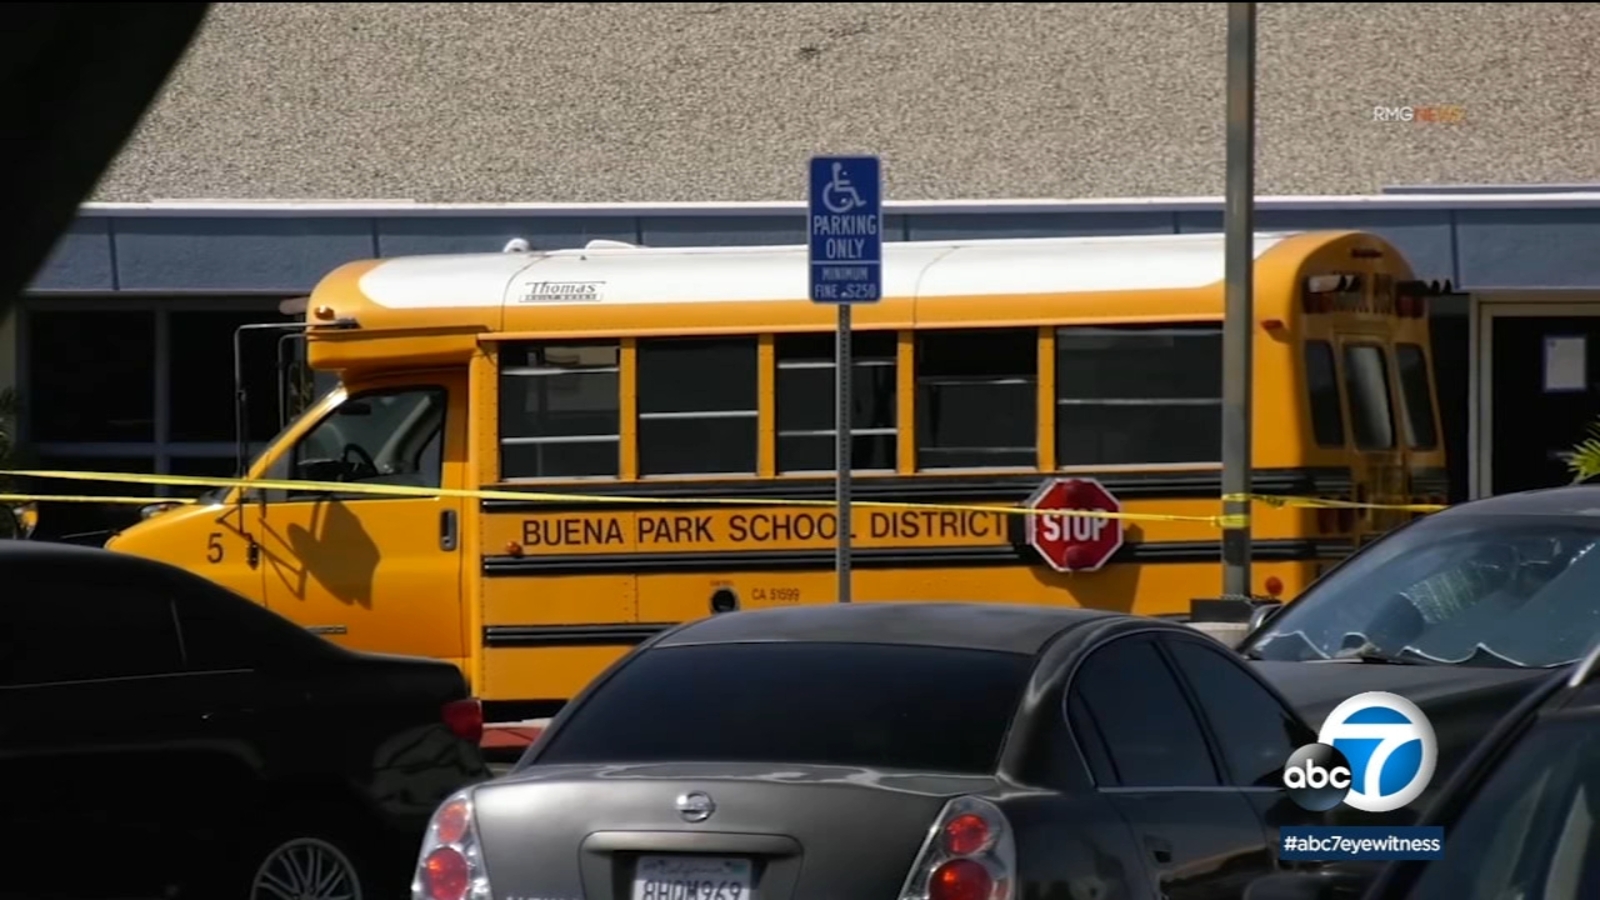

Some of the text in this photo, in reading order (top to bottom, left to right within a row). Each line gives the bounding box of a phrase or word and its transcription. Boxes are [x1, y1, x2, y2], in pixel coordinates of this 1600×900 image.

[813, 215, 877, 235] PARKING
[825, 238, 865, 259] ONLY
[822, 267, 868, 281] MINIMUM
[525, 281, 606, 295] Thomas
[814, 284, 838, 298] FINE
[522, 510, 1008, 546] BUENA PARK SCHOO DISTRICT
[1042, 508, 1109, 542] STOP
[206, 532, 224, 564] 5
[751, 588, 766, 601] CA
